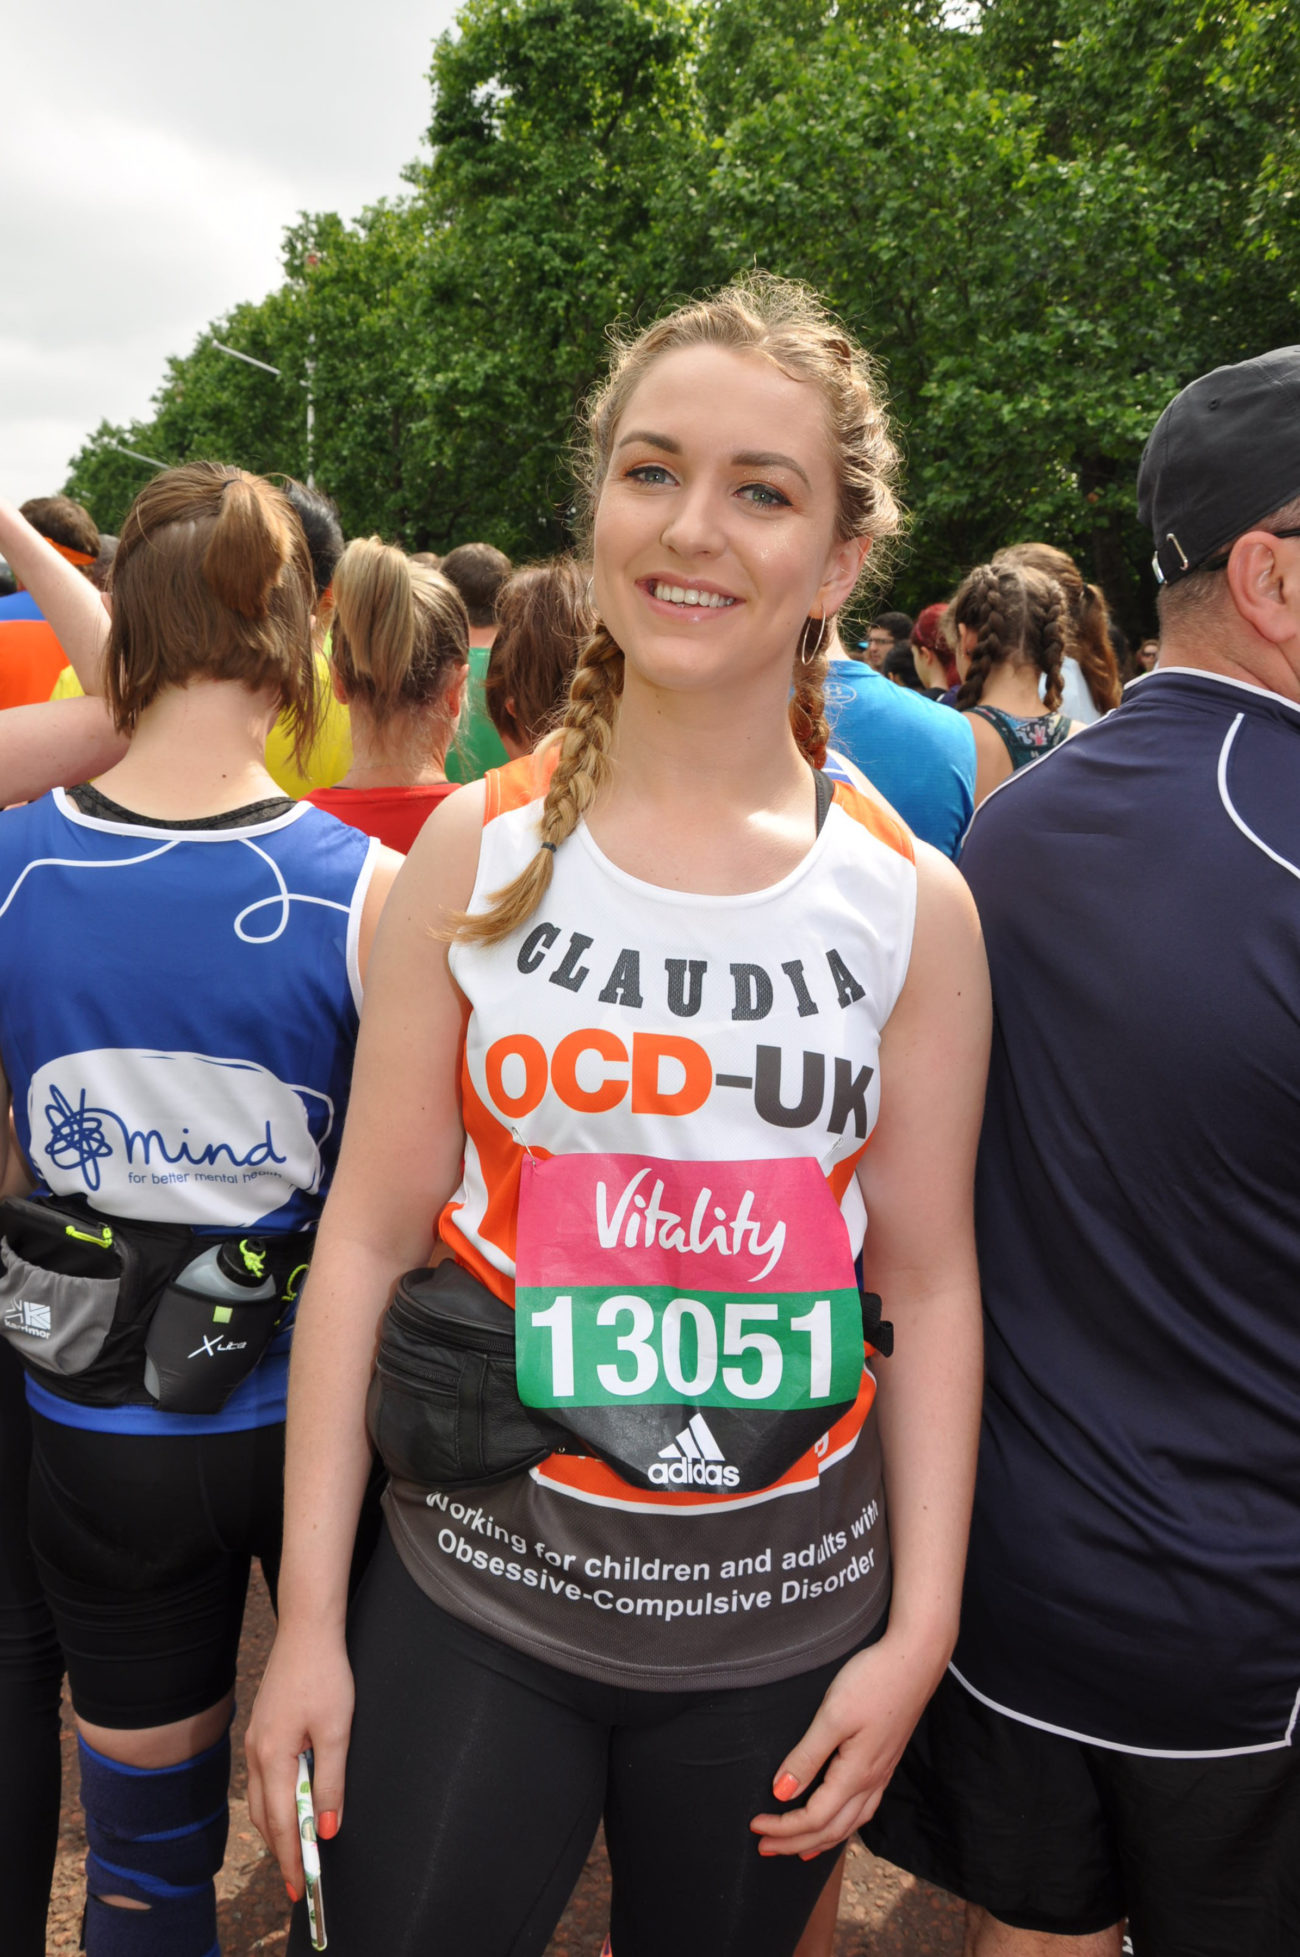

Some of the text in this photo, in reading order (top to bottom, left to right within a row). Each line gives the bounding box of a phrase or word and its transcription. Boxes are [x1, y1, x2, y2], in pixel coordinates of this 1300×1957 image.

[517, 921, 866, 1021] CLAUDIA
[485, 1028, 875, 1139] OCD-UK
[124, 1120, 287, 1167] mind
[128, 1172, 147, 1184] for
[151, 1172, 190, 1185] better
[194, 1172, 238, 1184] mental
[596, 1167, 787, 1282] Vitality
[531, 1295, 832, 1400] 13051
[647, 1456, 740, 1487] adidas
[426, 1491, 879, 1582] Working for children and adults with
[438, 1528, 875, 1622] Obsessive-Compulsive Disorder
